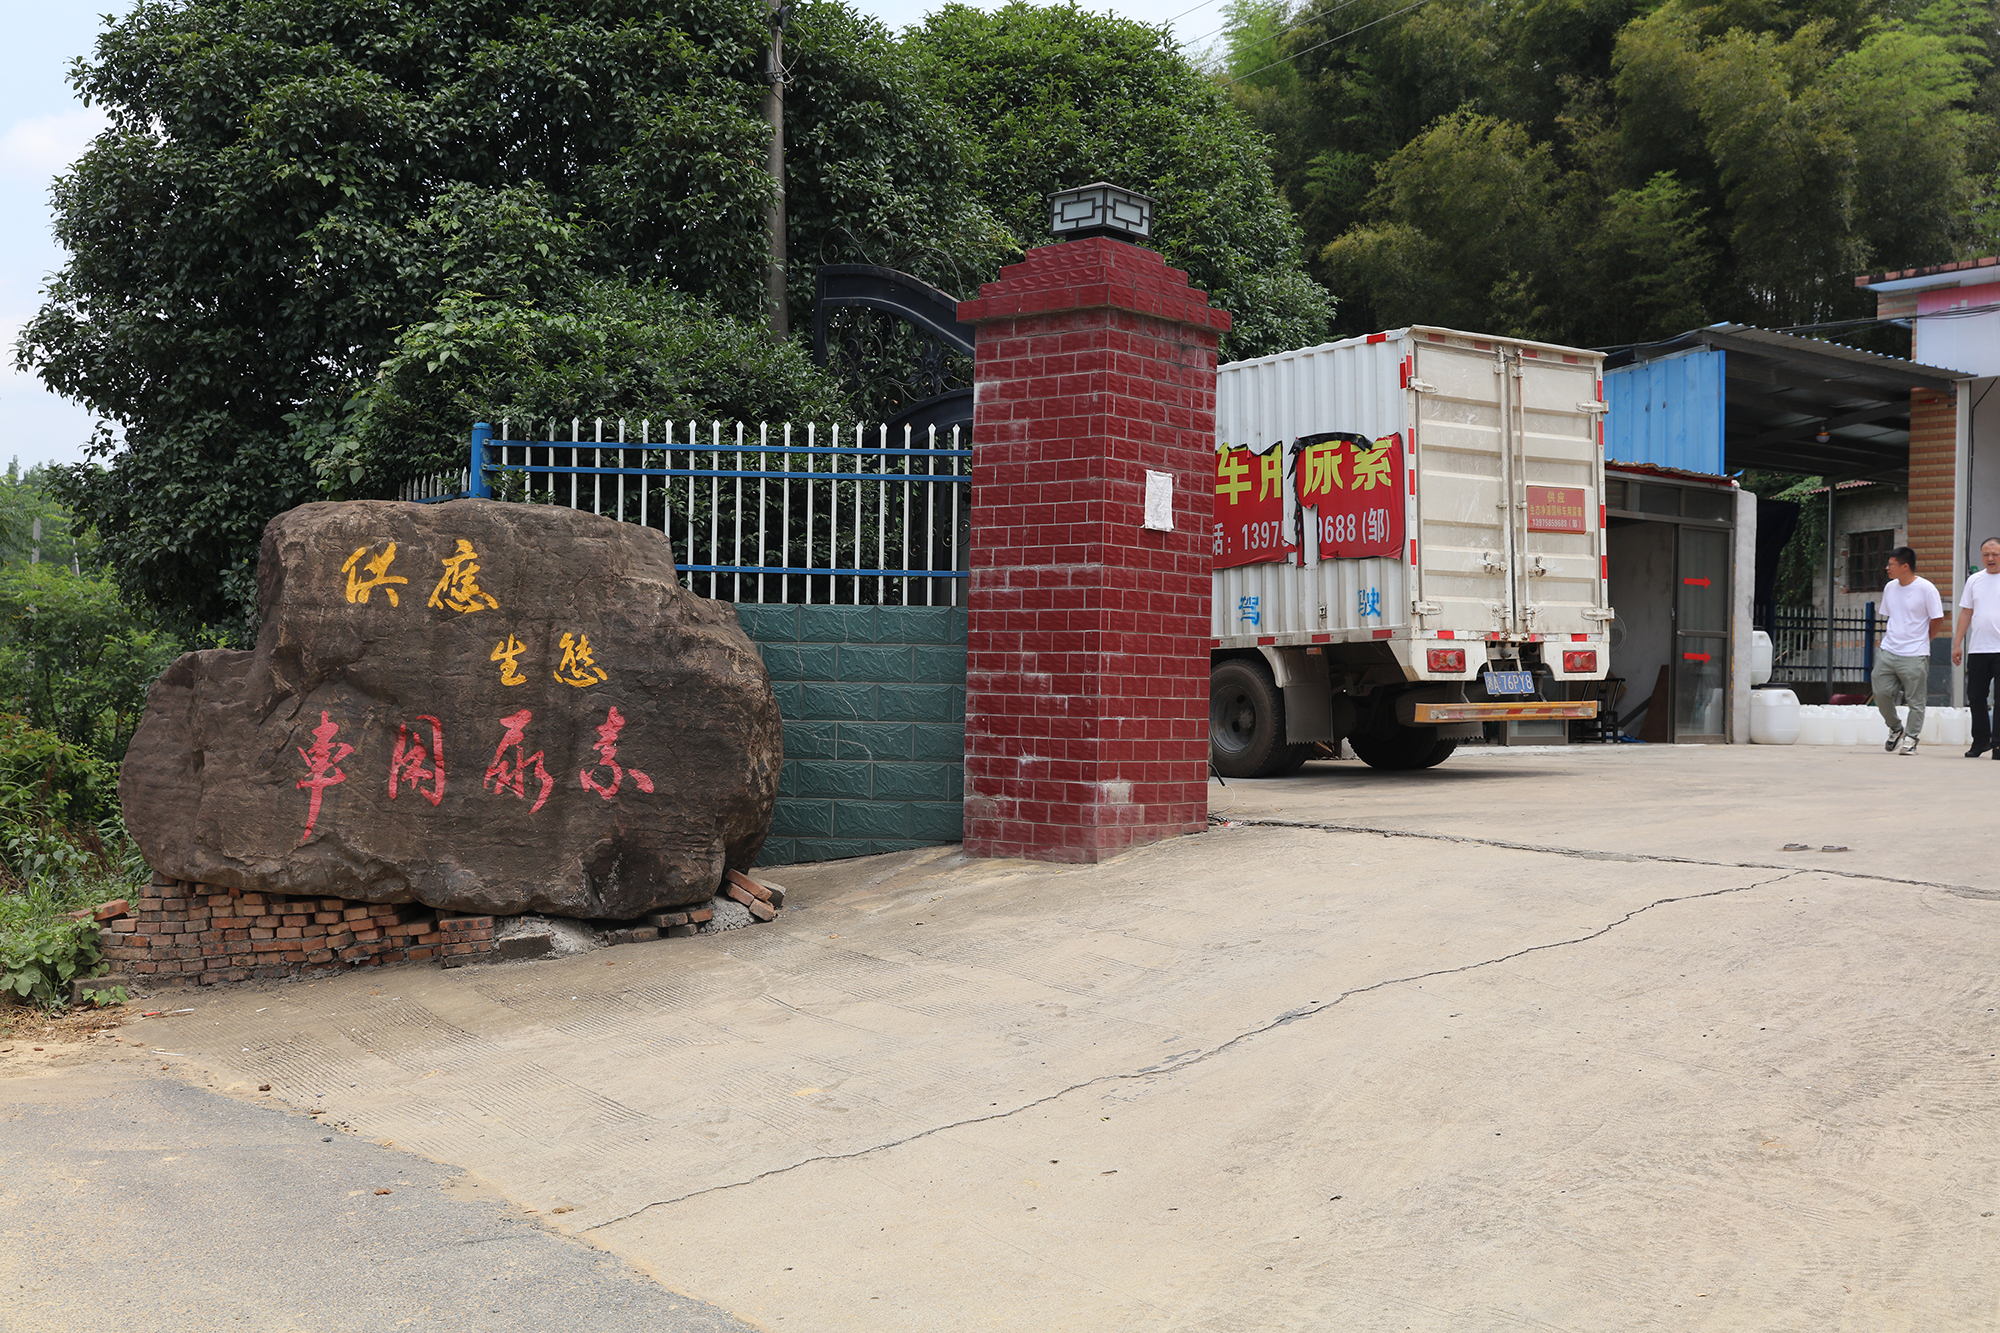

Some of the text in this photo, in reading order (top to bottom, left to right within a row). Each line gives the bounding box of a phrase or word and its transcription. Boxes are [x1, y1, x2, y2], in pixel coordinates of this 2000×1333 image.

[1547, 491, 1565, 503] 供应
[341, 539, 499, 613] 供應
[490, 632, 608, 688] 生態
[297, 706, 654, 841] 車用尿素
